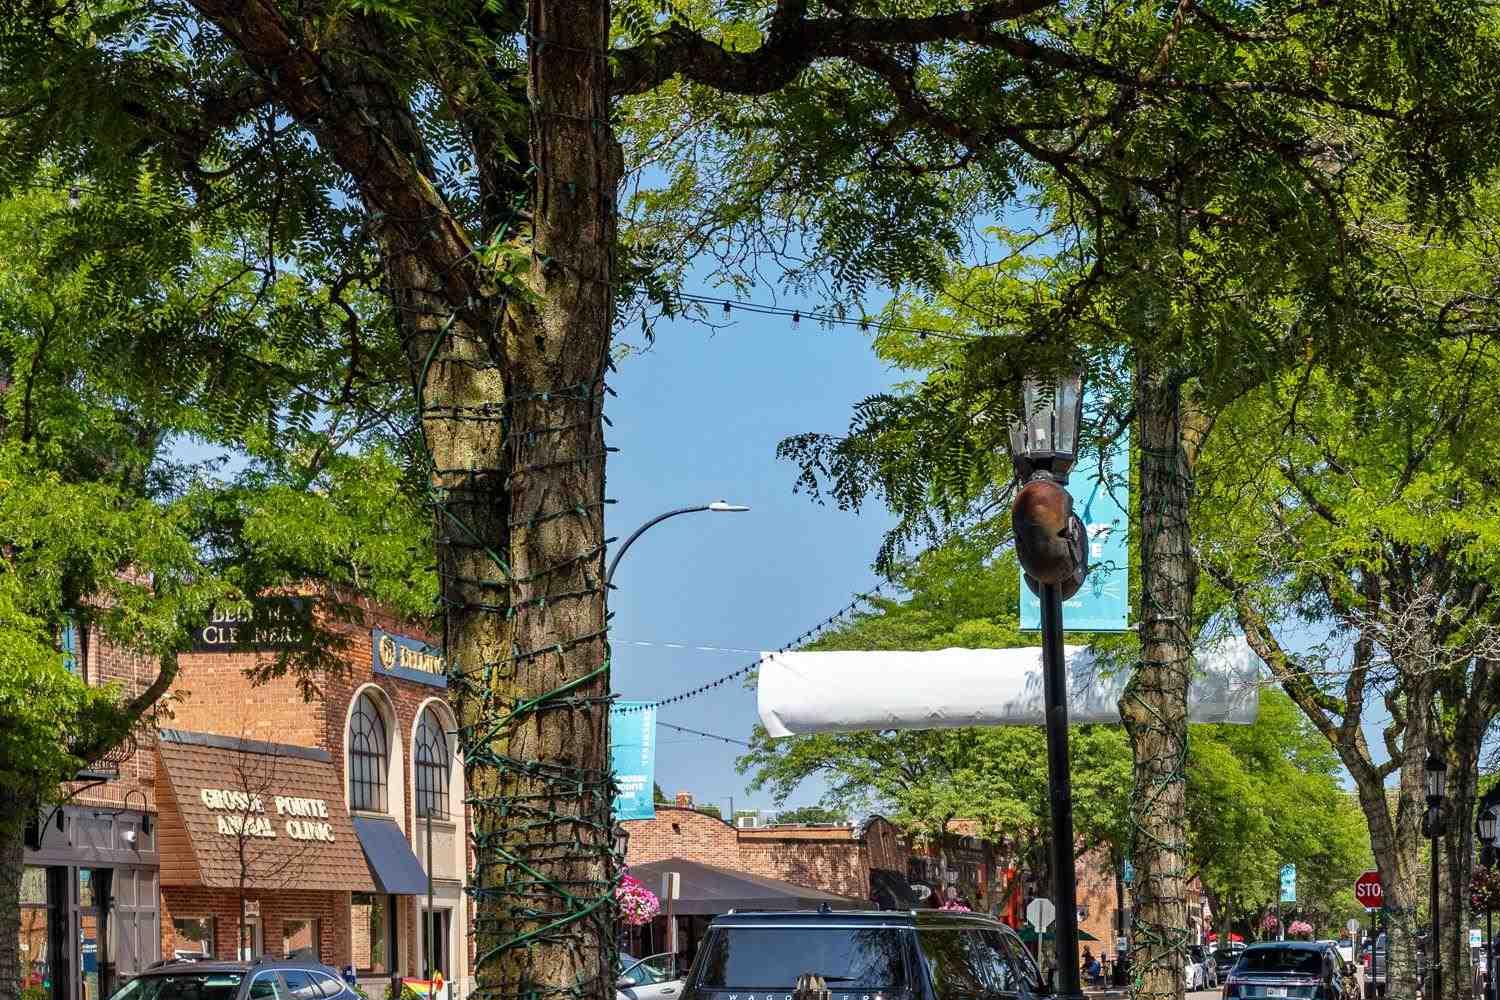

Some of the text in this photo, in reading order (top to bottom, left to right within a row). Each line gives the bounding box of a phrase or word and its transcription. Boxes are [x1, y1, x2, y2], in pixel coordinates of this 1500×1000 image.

[201, 789, 329, 818] GROSSE POINTE
[286, 820, 336, 842] CLINIC
[1357, 883, 1384, 897] STO
